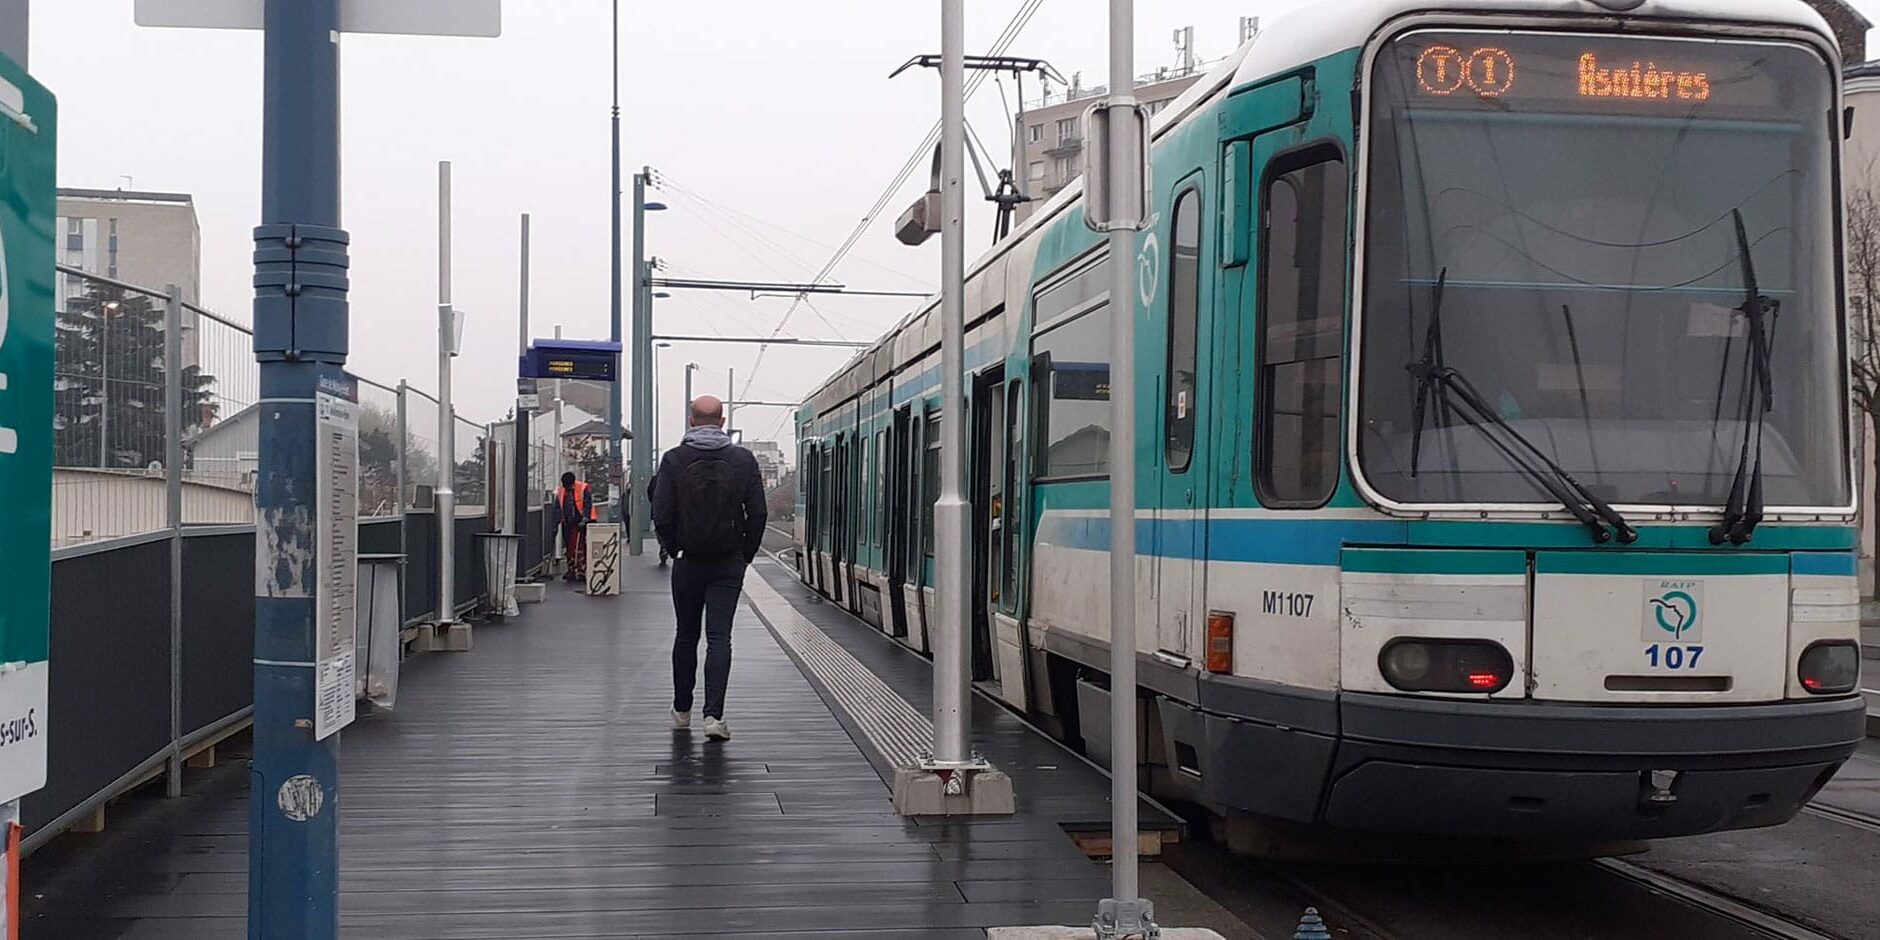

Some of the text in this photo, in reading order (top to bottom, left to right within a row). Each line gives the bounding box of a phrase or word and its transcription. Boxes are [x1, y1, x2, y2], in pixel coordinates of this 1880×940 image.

[1578, 52, 1711, 100] Asnières
[1262, 590, 1315, 618] M1107
[1645, 643, 1704, 670] 107
